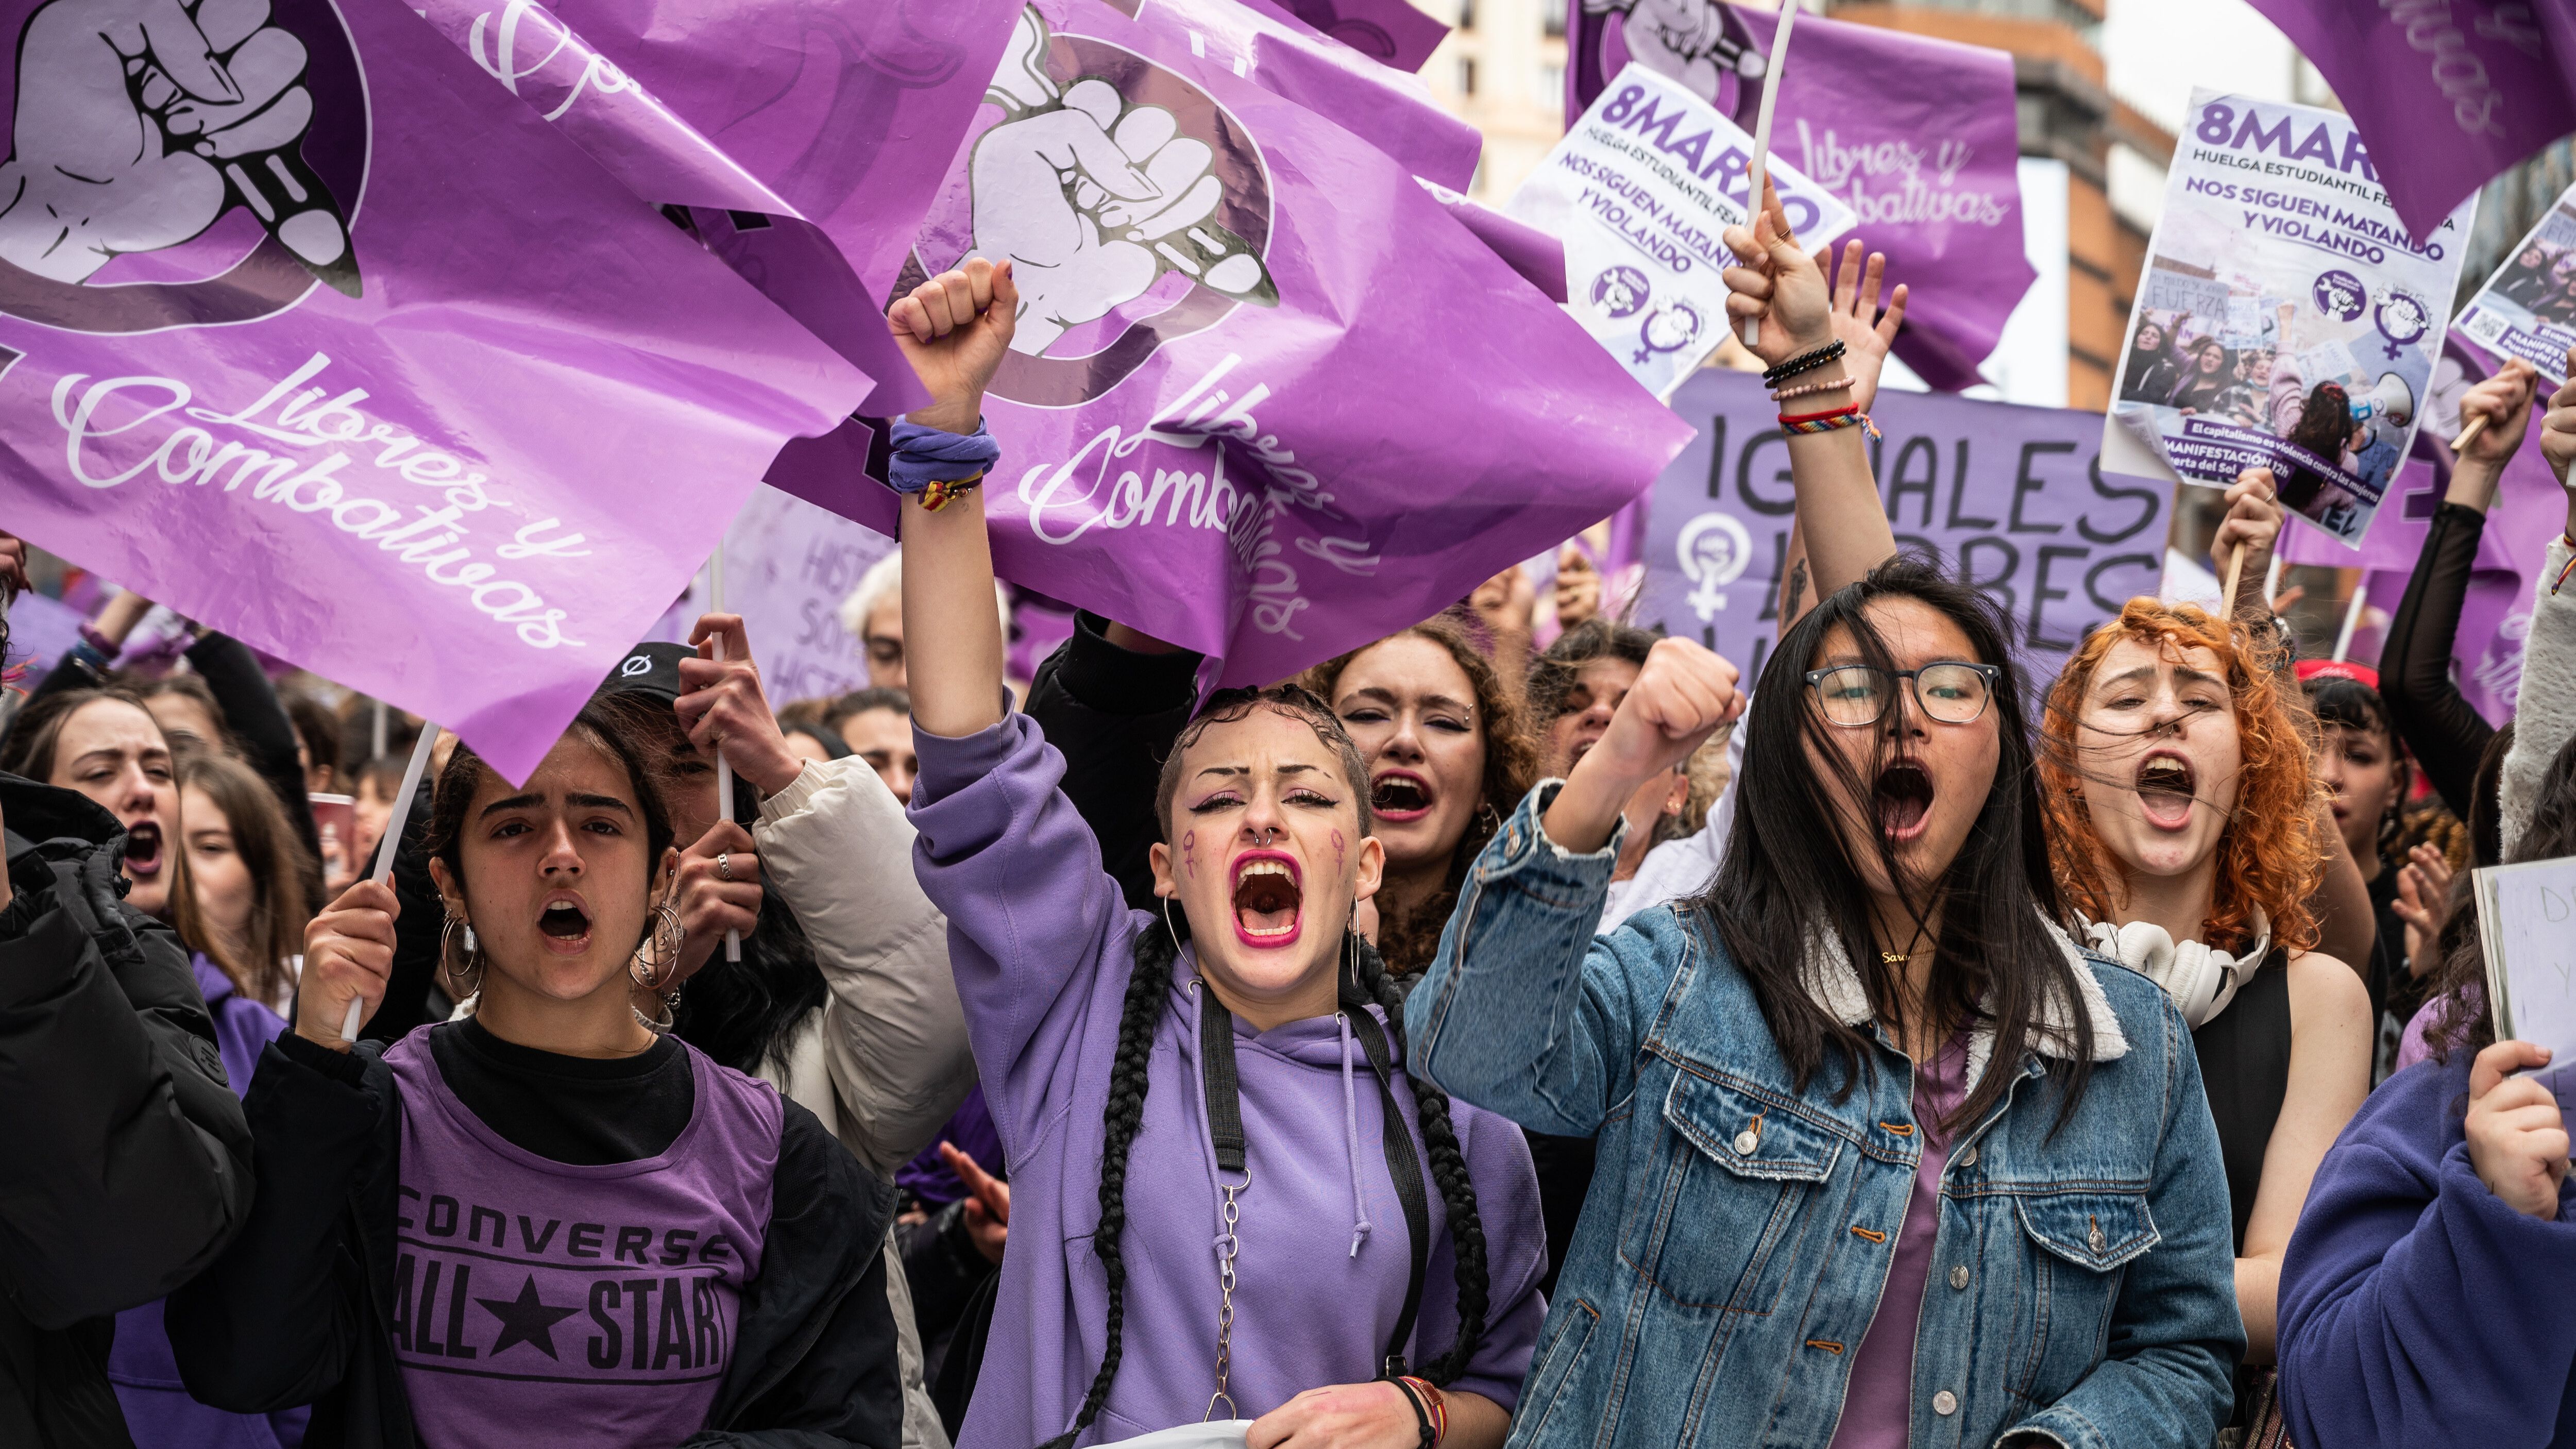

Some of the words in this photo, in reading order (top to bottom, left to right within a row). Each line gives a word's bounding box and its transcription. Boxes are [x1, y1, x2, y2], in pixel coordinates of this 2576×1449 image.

[1584, 125, 1630, 153] HUELGA
[1630, 146, 1713, 211] ESTUDIANTIL
[1938, 139, 1974, 186] y
[2193, 148, 2260, 172] HUELGA
[2266, 162, 2370, 200] ESTUDIANTIL
[2196, 104, 2382, 183] 8MAR
[1559, 151, 1598, 175] NOS
[1592, 166, 1665, 217] SIGUEN
[1658, 212, 1743, 269] MATAND
[1839, 178, 2010, 227] bativas
[2185, 176, 2236, 199] NOS
[2241, 187, 2330, 221] SIGUEN
[186, 351, 512, 512] Libres
[497, 517, 591, 560] y
[1708, 415, 2159, 543] IGALES
[2192, 423, 2204, 434] El
[2204, 426, 2262, 445] capitalismo
[2263, 437, 2275, 449] es
[2275, 441, 2314, 466] violencia
[2312, 460, 2338, 480] contra
[2337, 470, 2349, 486] las
[2348, 479, 2380, 503] mujeres
[2198, 459, 2216, 471] del
[2218, 462, 2237, 475] Sol
[2272, 462, 2289, 479] 12h
[52, 374, 586, 649] Combativas
[1295, 536, 1381, 577] y
[392, 1253, 477, 1359] ALL
[587, 1276, 719, 1370] STAR
